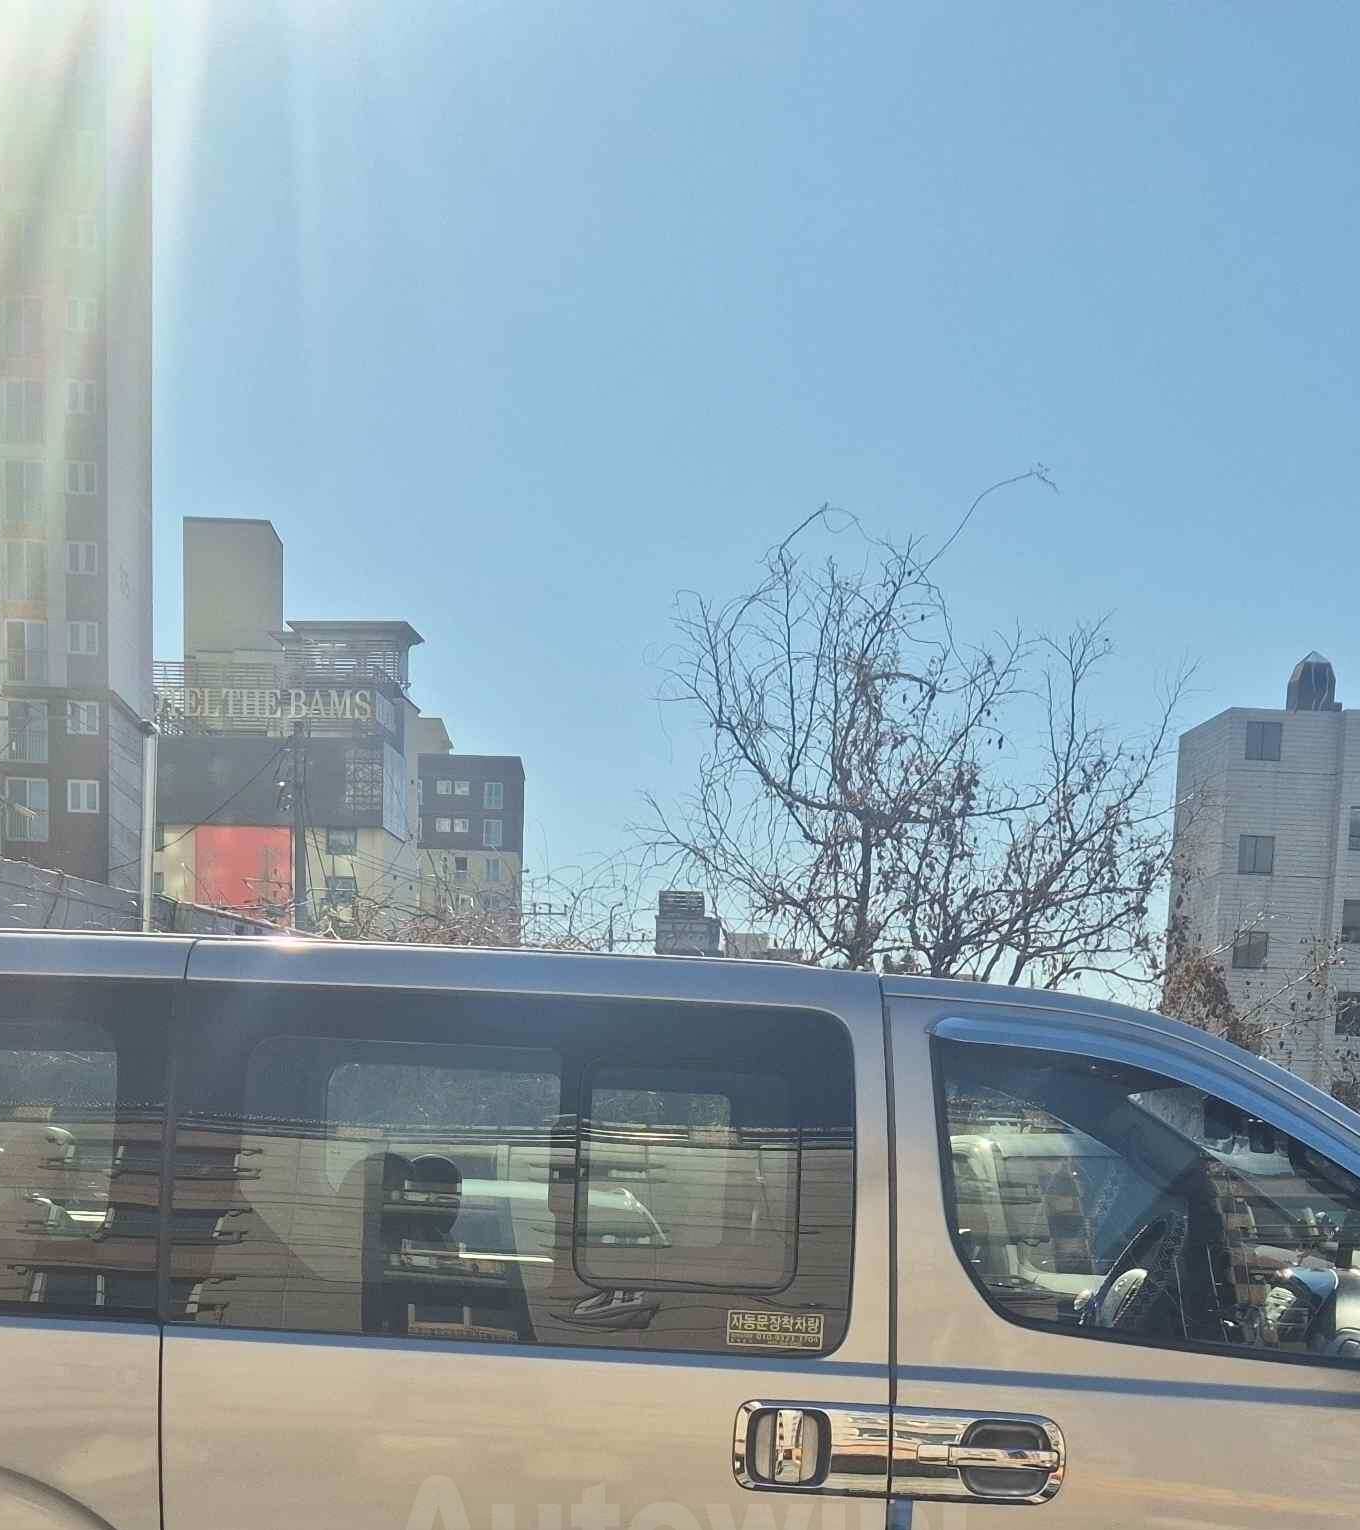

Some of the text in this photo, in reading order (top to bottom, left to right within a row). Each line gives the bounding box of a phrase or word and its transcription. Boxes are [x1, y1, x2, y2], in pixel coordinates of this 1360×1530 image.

[222, 688, 281, 718] THE
[288, 688, 373, 720] BAMS
[730, 1312, 819, 1334] 자동문장착차량
